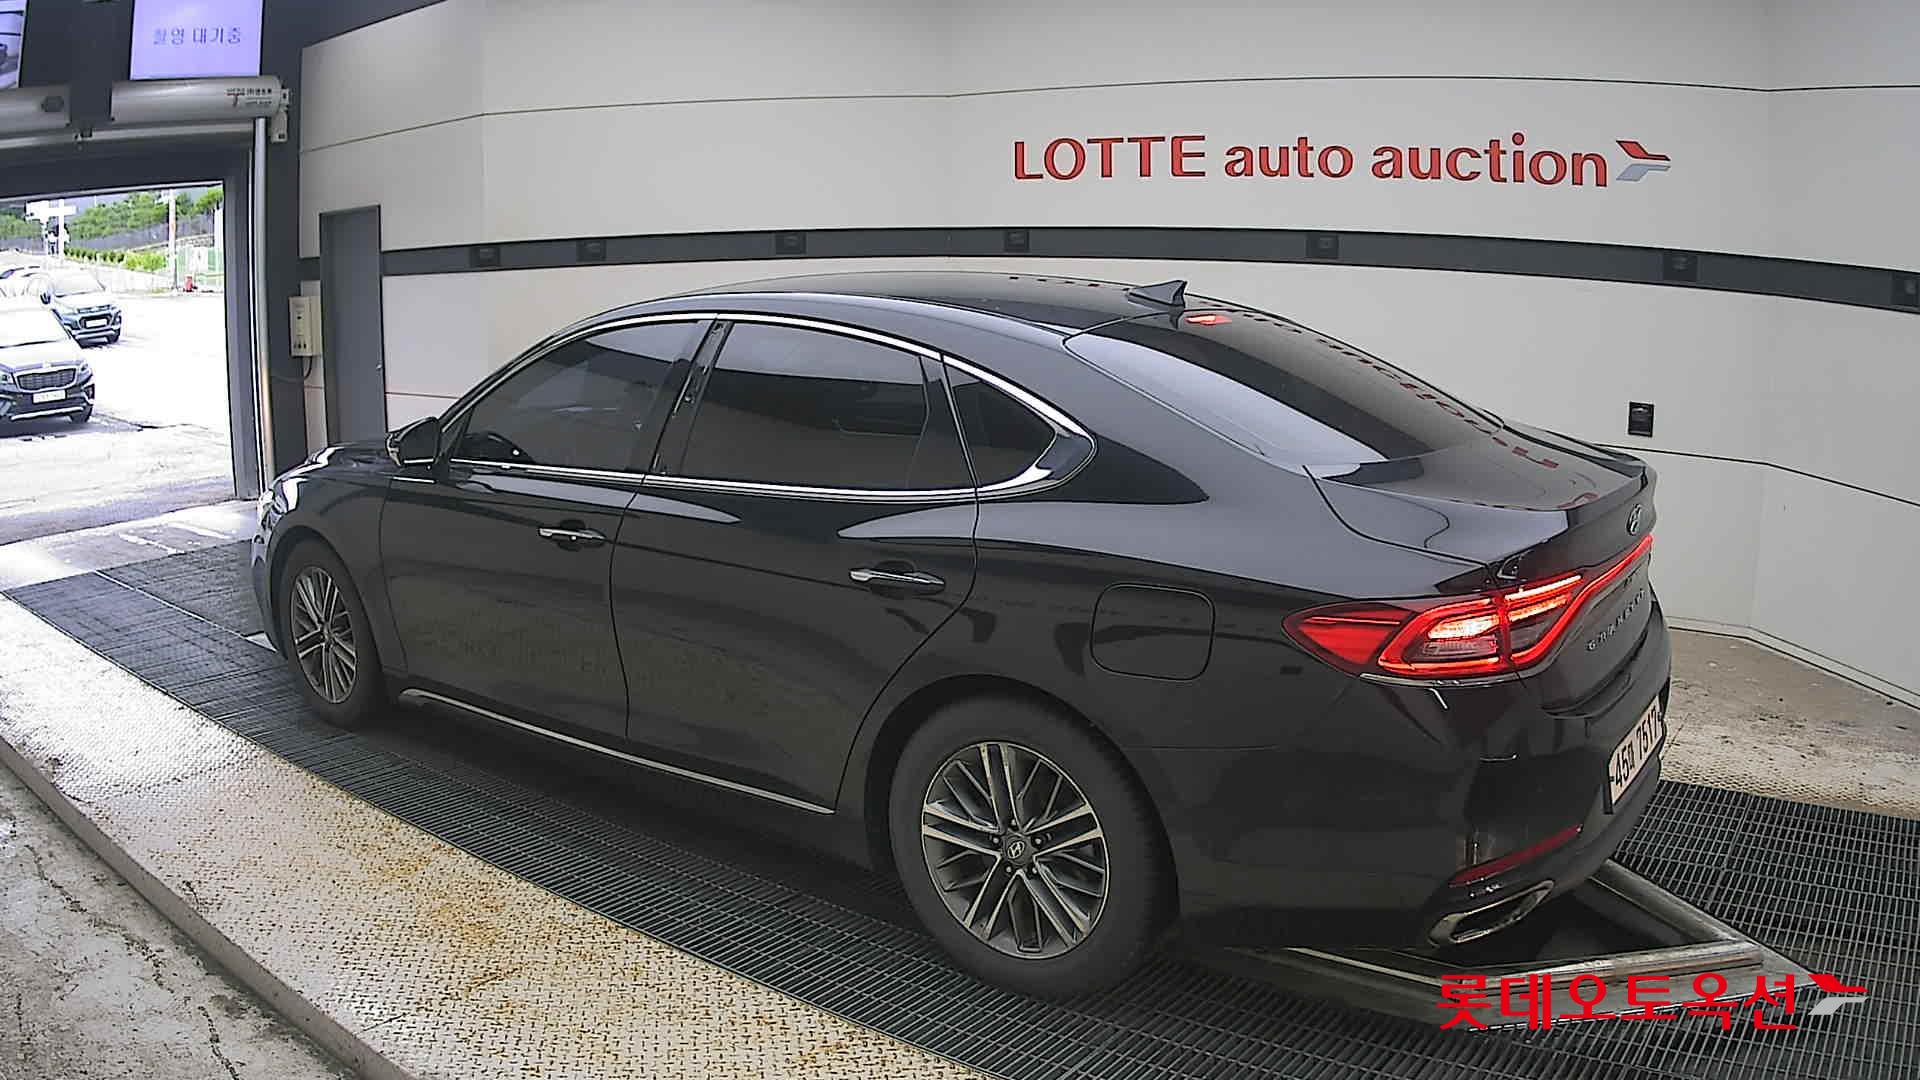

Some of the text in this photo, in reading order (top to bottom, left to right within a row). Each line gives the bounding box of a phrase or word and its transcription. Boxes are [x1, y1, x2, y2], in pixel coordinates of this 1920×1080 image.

[1014, 132, 1607, 187] LOTTE auto auction
